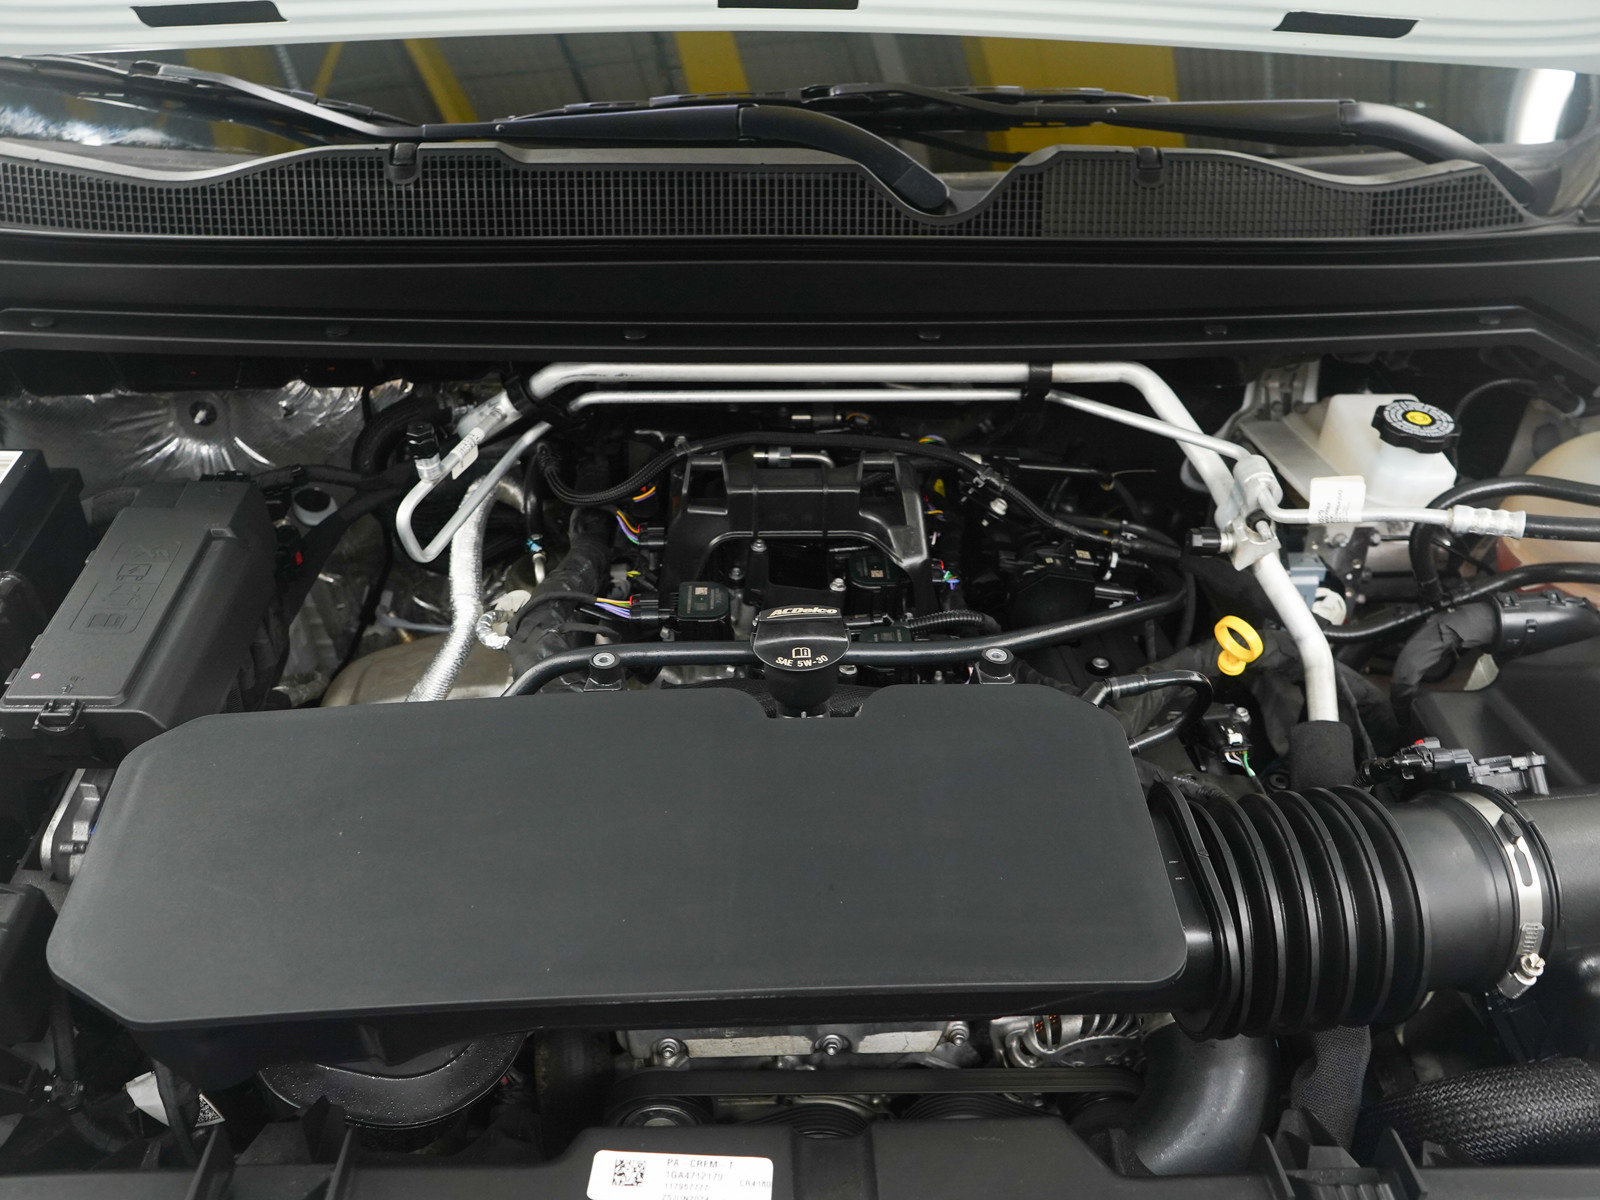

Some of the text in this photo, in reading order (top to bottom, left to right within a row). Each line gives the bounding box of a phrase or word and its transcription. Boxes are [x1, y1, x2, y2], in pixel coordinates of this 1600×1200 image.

[768, 606, 838, 618] ACDelco
[775, 654, 829, 668] SAE 5W-30
[666, 1158, 680, 1167] PA
